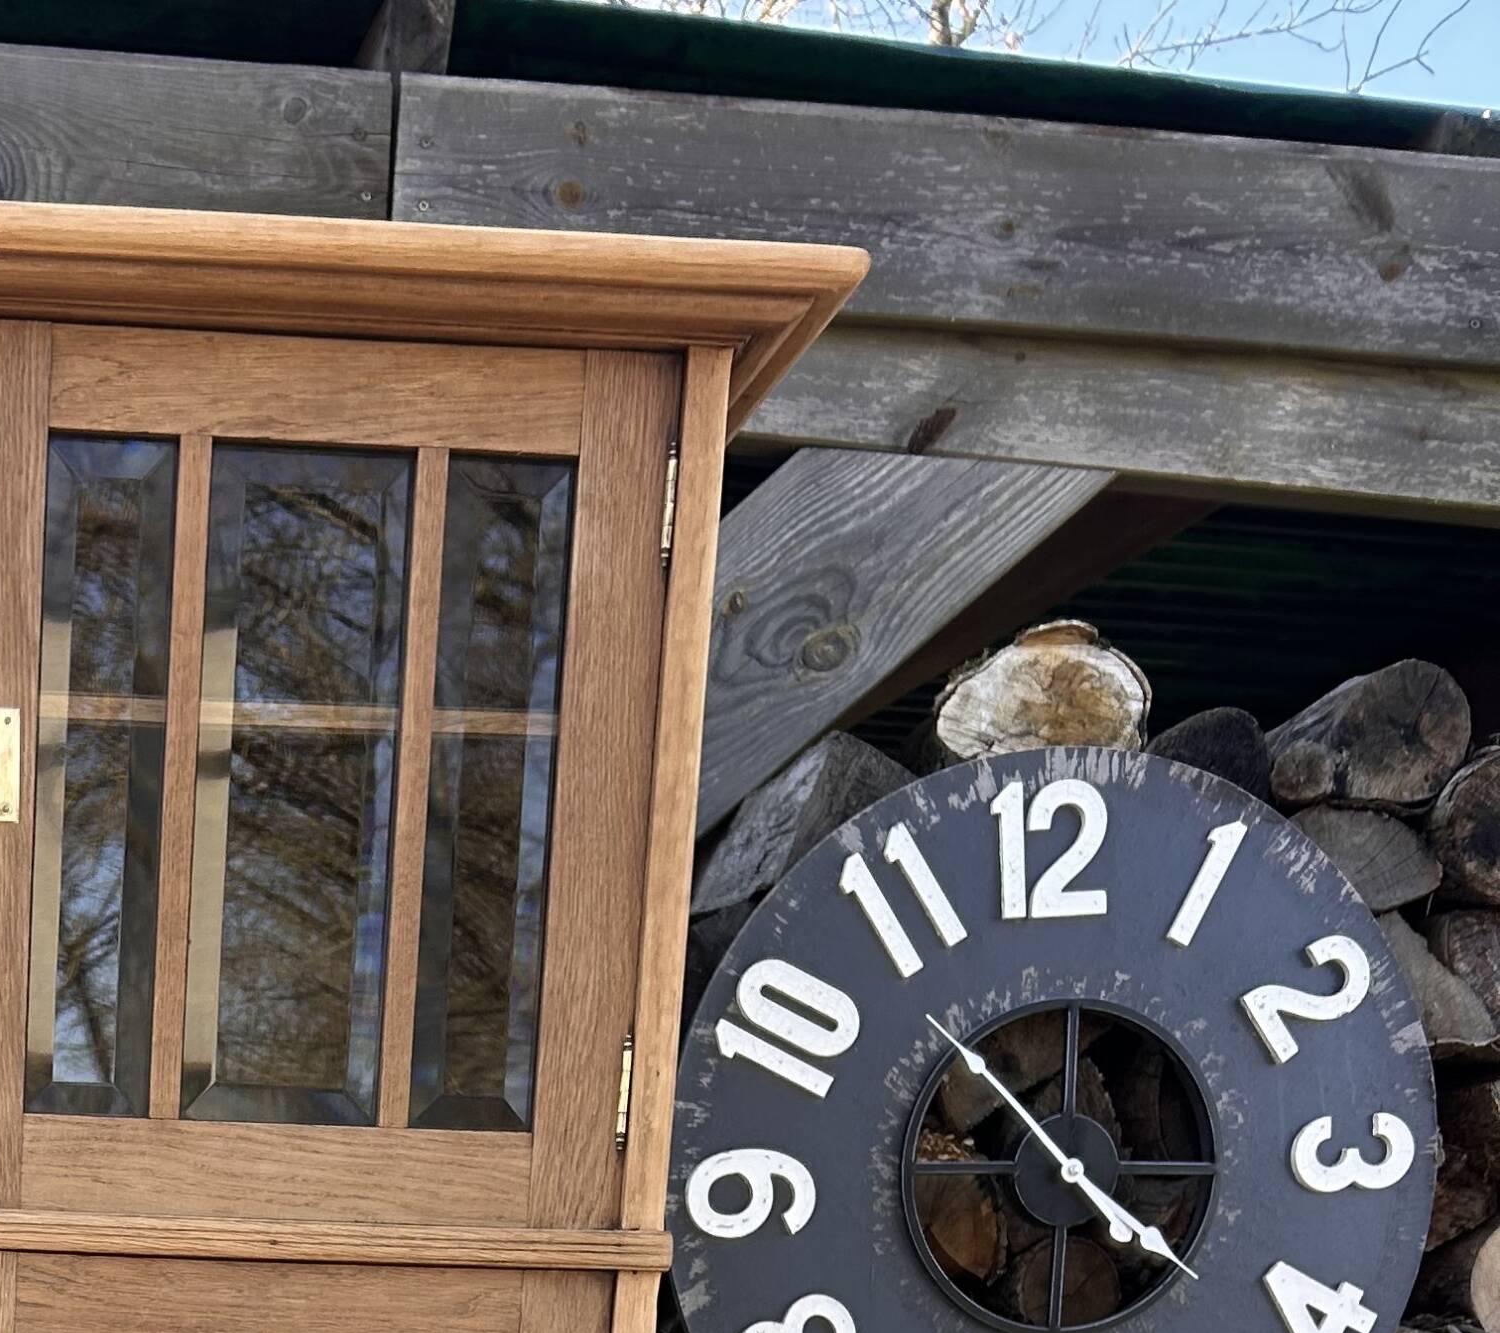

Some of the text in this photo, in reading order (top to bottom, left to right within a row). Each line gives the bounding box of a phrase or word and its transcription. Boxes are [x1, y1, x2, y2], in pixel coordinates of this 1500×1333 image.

[838, 822, 968, 978] 11
[990, 778, 1108, 920] 12
[1166, 820, 1248, 947] 1
[714, 958, 861, 1099] 10
[1241, 934, 1373, 1064] 2
[685, 1148, 817, 1239] 9
[1290, 1111, 1416, 1193] 3
